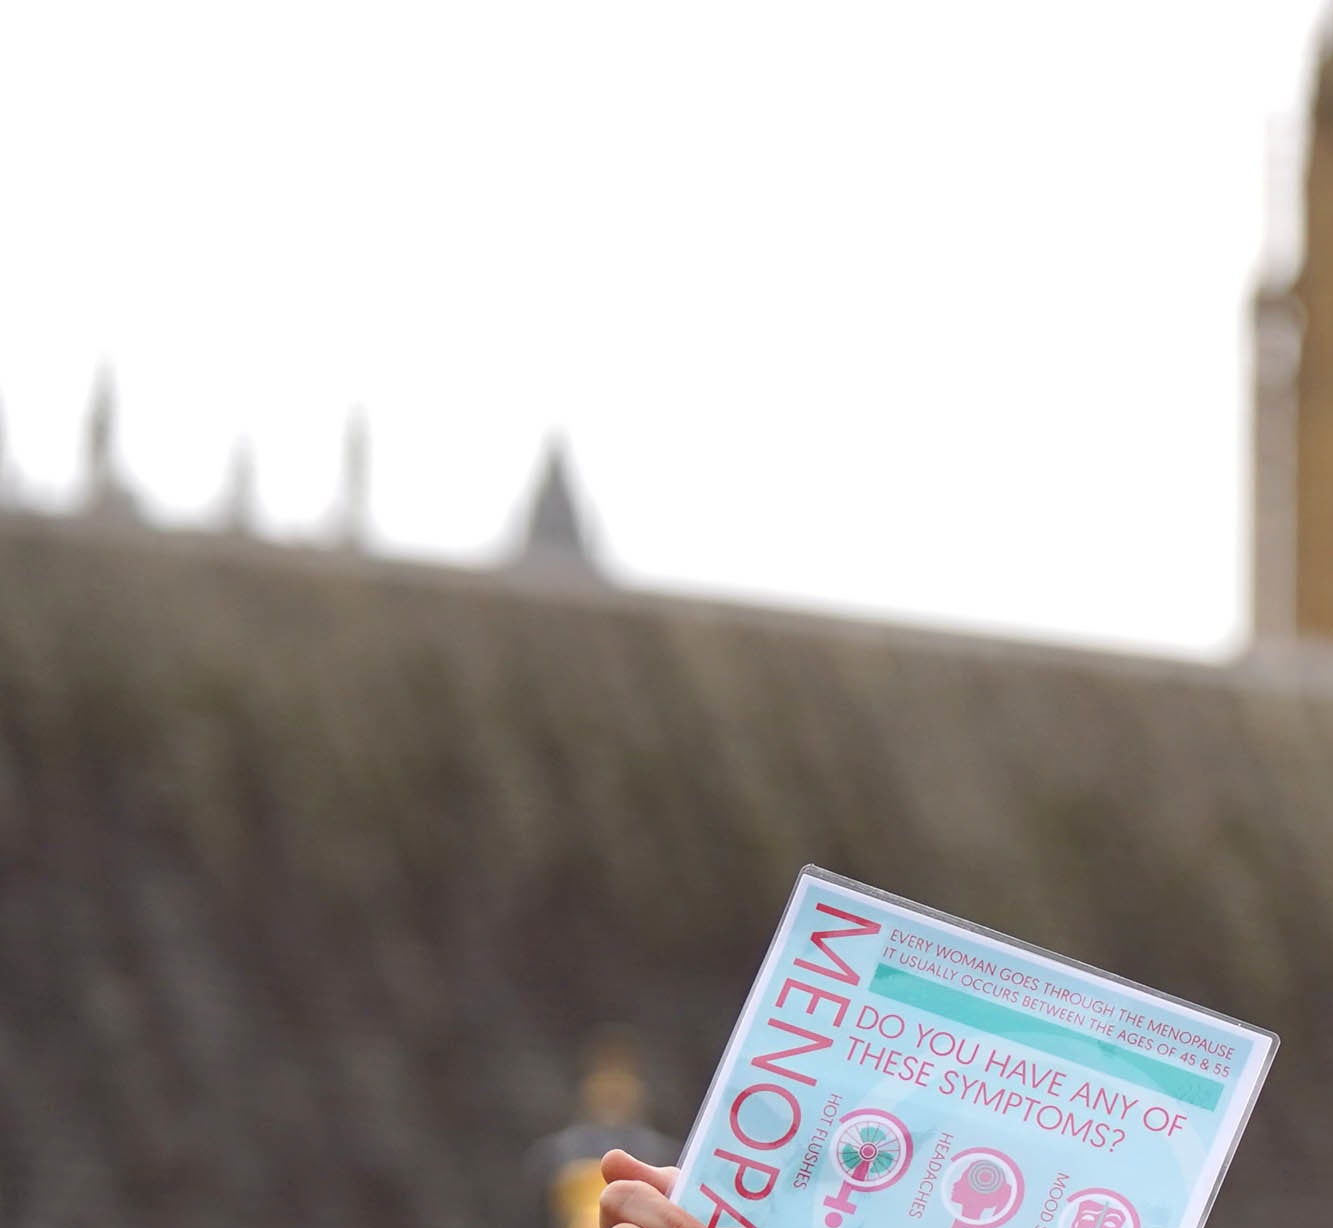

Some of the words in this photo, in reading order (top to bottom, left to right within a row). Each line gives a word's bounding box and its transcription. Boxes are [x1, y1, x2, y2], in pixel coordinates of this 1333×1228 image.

[883, 947, 896, 958] IT
[899, 954, 958, 980] USUALLY
[960, 974, 1018, 1003] OCCURS
[1022, 995, 1084, 1025] BETWEEN
[1091, 1018, 1112, 1037] THE
[1117, 1030, 1153, 1050] AGES
[1156, 1044, 1175, 1057] OF
[1180, 1053, 1195, 1066] 45
[1198, 1060, 1209, 1072] &
[1213, 1063, 1229, 1078] 55
[890, 929, 932, 952] EVERY
[936, 944, 996, 976] WOMAN
[998, 968, 1039, 991] GOES
[1043, 982, 1114, 1014] THROUGH
[1119, 1009, 1144, 1028] THE
[1148, 1019, 1233, 1060] MENOPAUSE
[820, 1094, 841, 1125] HOT
[846, 1036, 934, 1088] THESE
[938, 1070, 1126, 1152] SYMPTOMS?
[856, 1005, 905, 1039] DO
[916, 1024, 979, 1065] YOU
[984, 1050, 1066, 1097] HAVE
[1069, 1082, 1138, 1119] ANY
[1142, 1106, 1187, 1136] OF
[793, 1128, 827, 1188] FLUSHES
[907, 1133, 955, 1218] HEADACHES
[1040, 1174, 1070, 1222] MOOD
